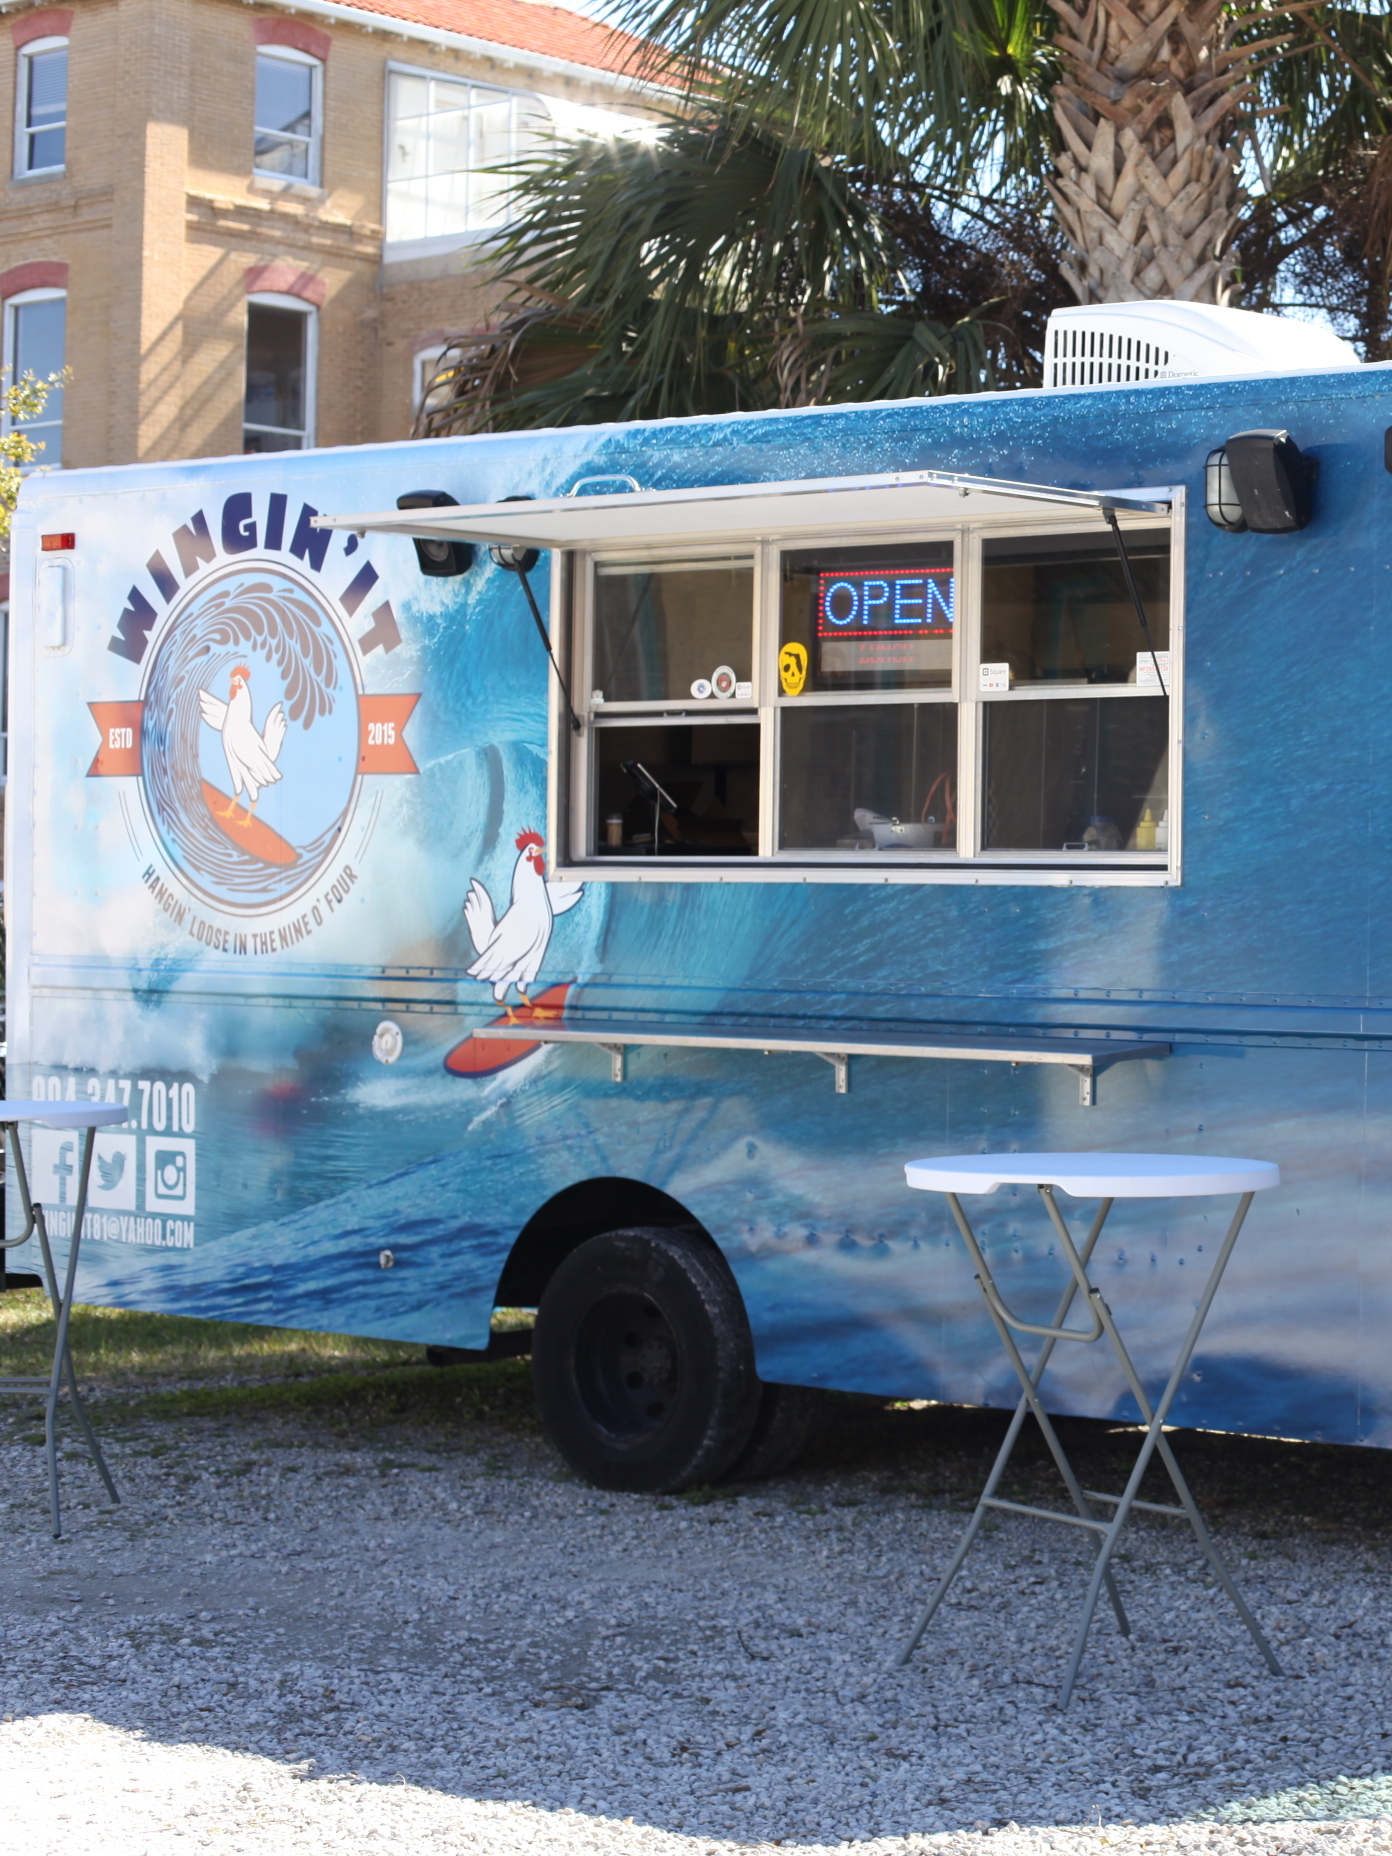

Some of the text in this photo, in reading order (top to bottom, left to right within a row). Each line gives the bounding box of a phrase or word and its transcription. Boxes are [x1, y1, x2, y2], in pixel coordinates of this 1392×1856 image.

[825, 577, 955, 626] OPEN
[108, 727, 133, 749] ESTD
[367, 722, 396, 746] 2015
[141, 863, 191, 926] HANGIN'
[189, 915, 230, 952] LOOSE
[233, 932, 248, 956] IN
[252, 930, 277, 955] THE
[278, 913, 313, 950] NINE
[323, 864, 358, 913] FOUR
